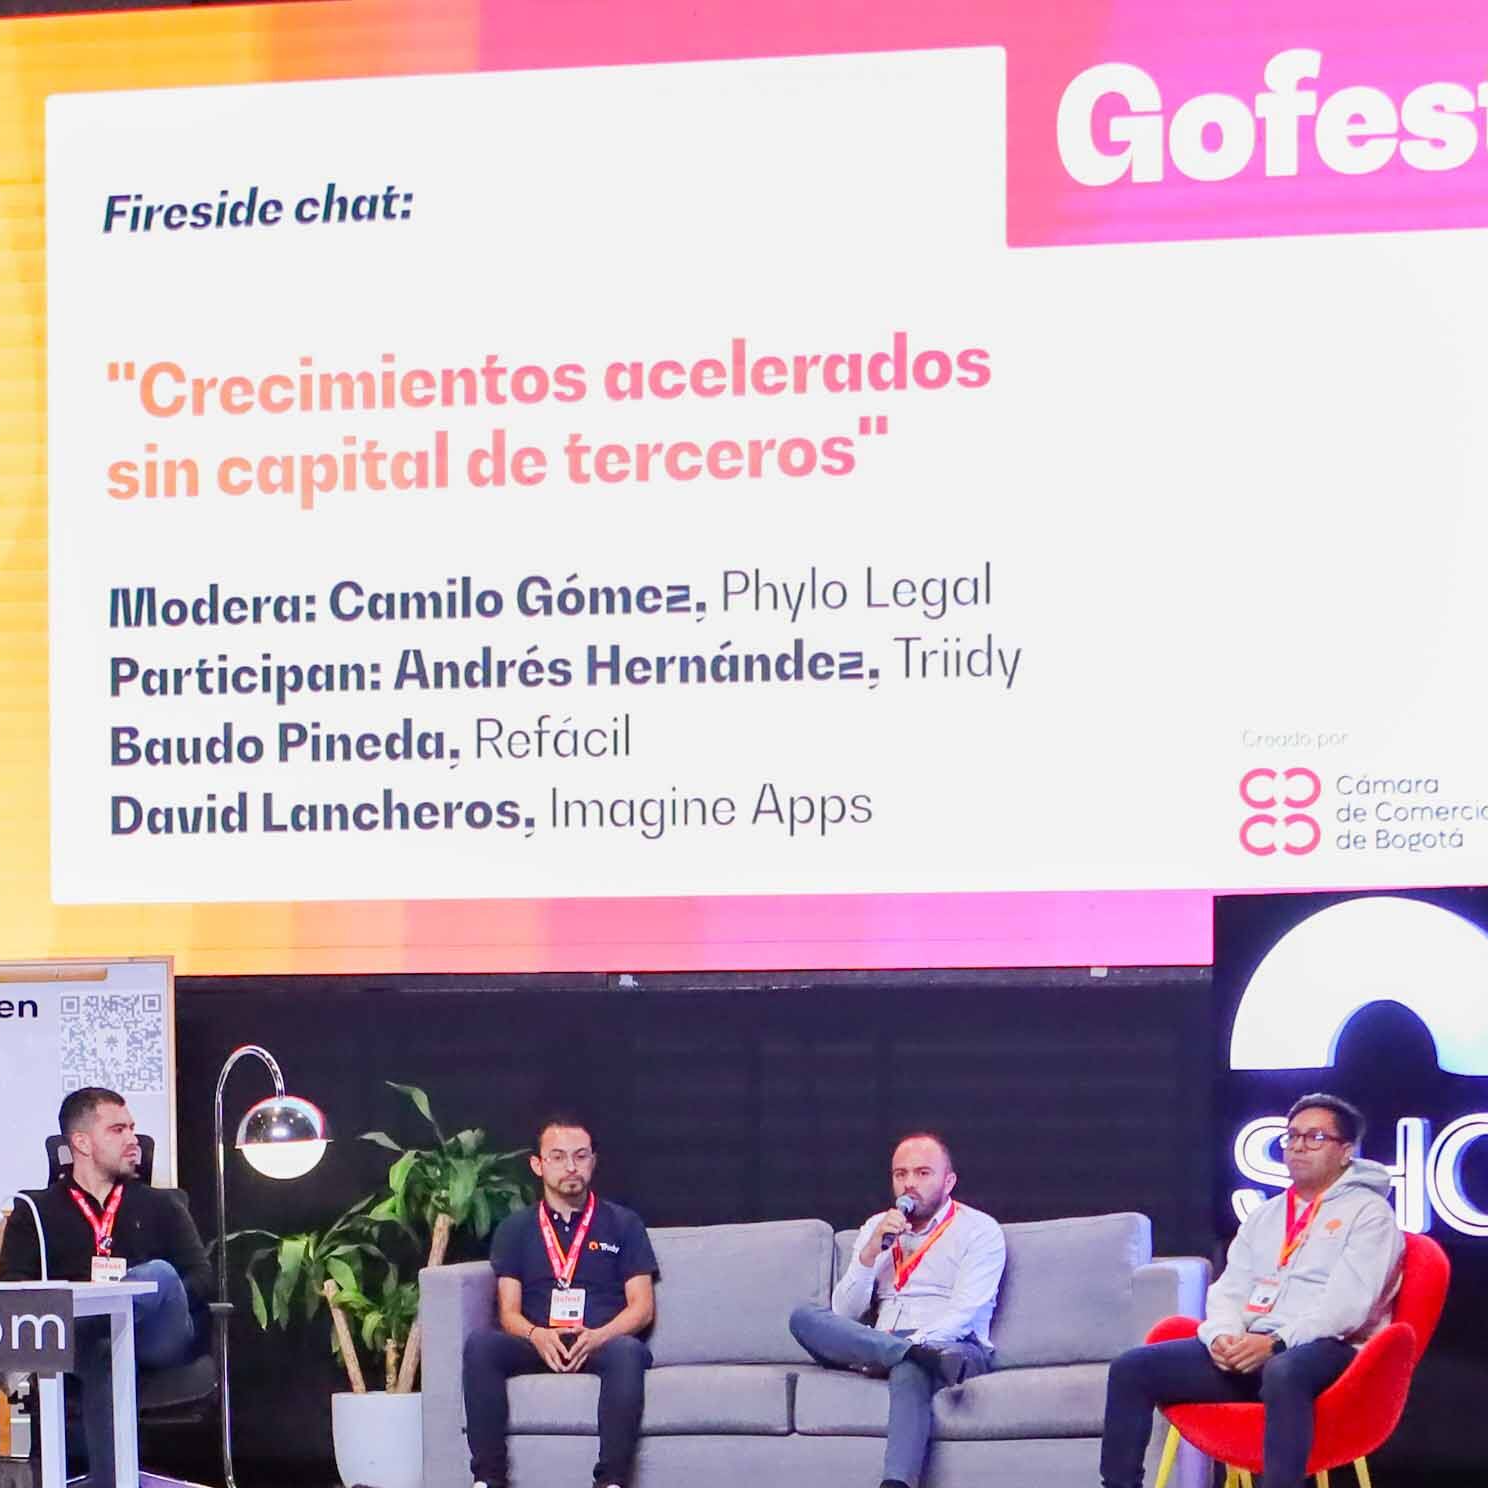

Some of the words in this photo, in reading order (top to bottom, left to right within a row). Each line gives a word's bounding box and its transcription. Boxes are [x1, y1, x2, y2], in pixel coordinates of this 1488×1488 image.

[103, 186, 284, 233] Fireside
[294, 183, 414, 224] chat:
[107, 354, 587, 417] "Crecimientos
[604, 331, 992, 401] acelerados
[107, 443, 200, 500] sin
[218, 430, 449, 510] capital
[468, 429, 548, 488] de
[564, 416, 889, 484] terceros"
[110, 584, 316, 628] Modera:
[329, 576, 504, 621] Camilo
[517, 573, 707, 623] Gómez,
[723, 567, 848, 622] Phylo
[867, 561, 991, 620] Legal
[111, 653, 381, 707] Participan:
[394, 645, 573, 691] Andrés
[587, 638, 880, 690] Hernández,
[894, 634, 1022, 690] Triidy
[111, 722, 264, 767] Baudo
[279, 718, 461, 769] Pineda,
[476, 714, 630, 759] Refácil
[111, 792, 248, 836] David
[263, 789, 536, 838] Lancheros,
[552, 787, 736, 840] Imagine
[752, 784, 874, 837] Apps
[1336, 773, 1439, 796] Cámara
[1336, 803, 1367, 823] de
[1336, 830, 1367, 850] de
[1375, 828, 1464, 852] Bogotá
